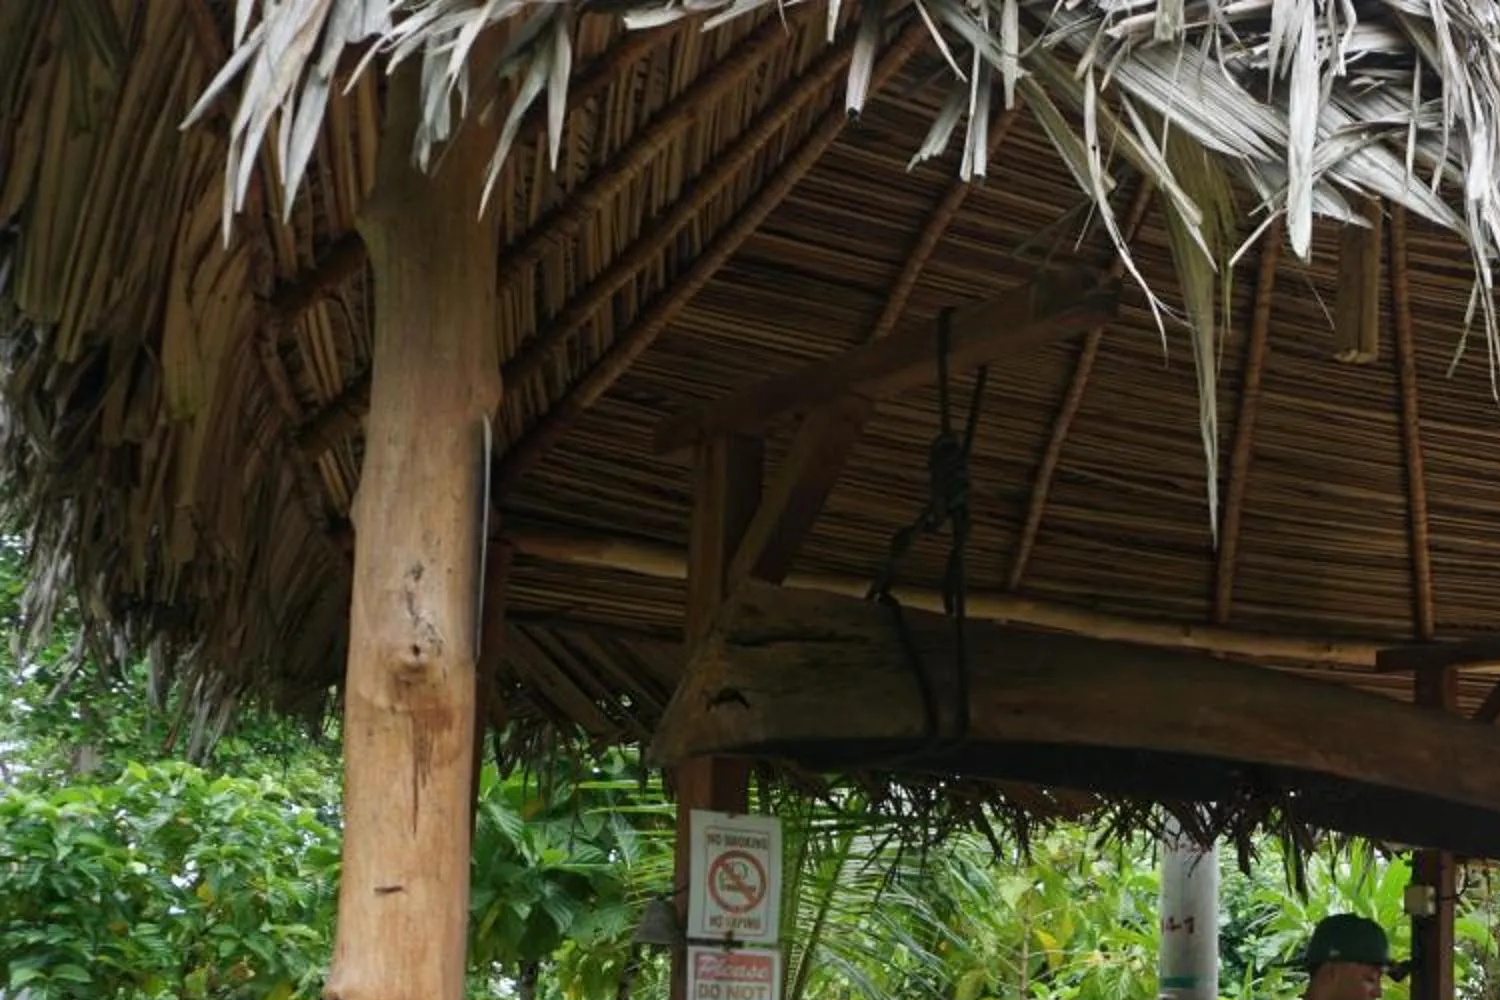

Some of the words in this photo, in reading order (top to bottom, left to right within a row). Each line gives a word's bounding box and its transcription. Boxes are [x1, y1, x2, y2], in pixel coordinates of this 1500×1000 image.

[706, 832, 721, 846] NO
[724, 834, 769, 850] SMOKING
[709, 915, 722, 928] NO
[699, 954, 768, 979] Please
[698, 983, 720, 999] DO
